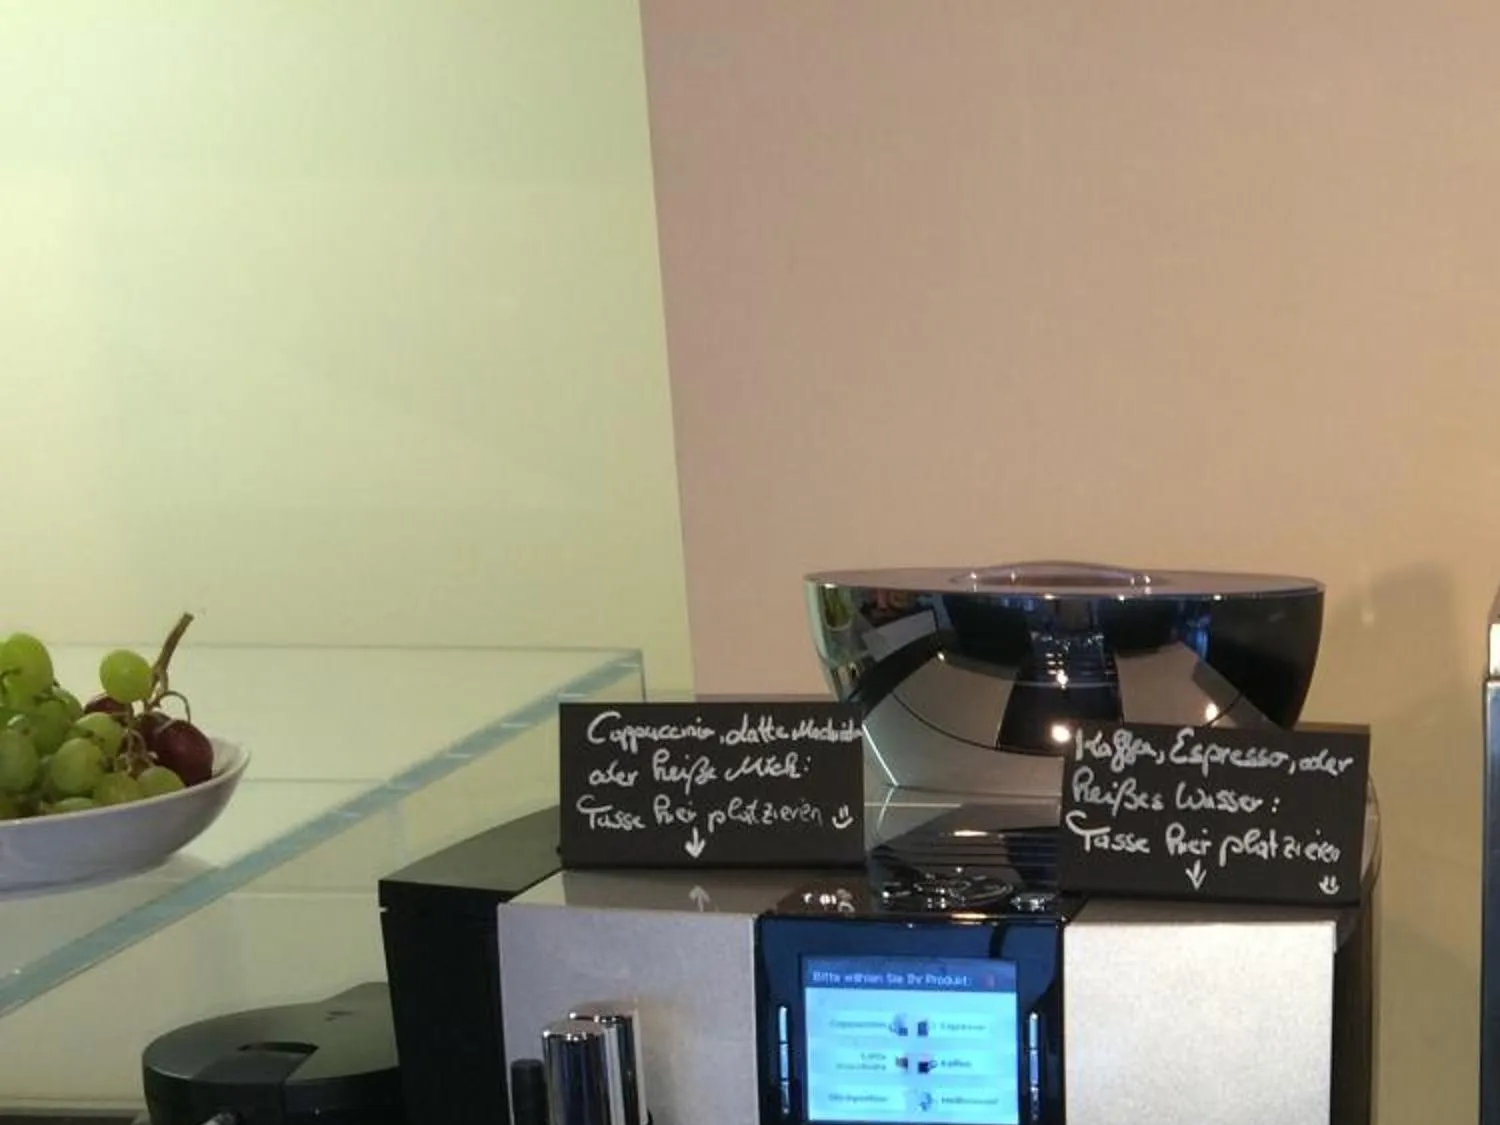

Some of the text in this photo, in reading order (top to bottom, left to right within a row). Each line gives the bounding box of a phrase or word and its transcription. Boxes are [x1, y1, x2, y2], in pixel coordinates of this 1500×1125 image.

[588, 760, 639, 786] oder
[1299, 749, 1354, 777] oder
[576, 794, 823, 833] Tasse hier platzieren
[1066, 810, 1151, 852] Tasse
[1166, 822, 1213, 856] hier
